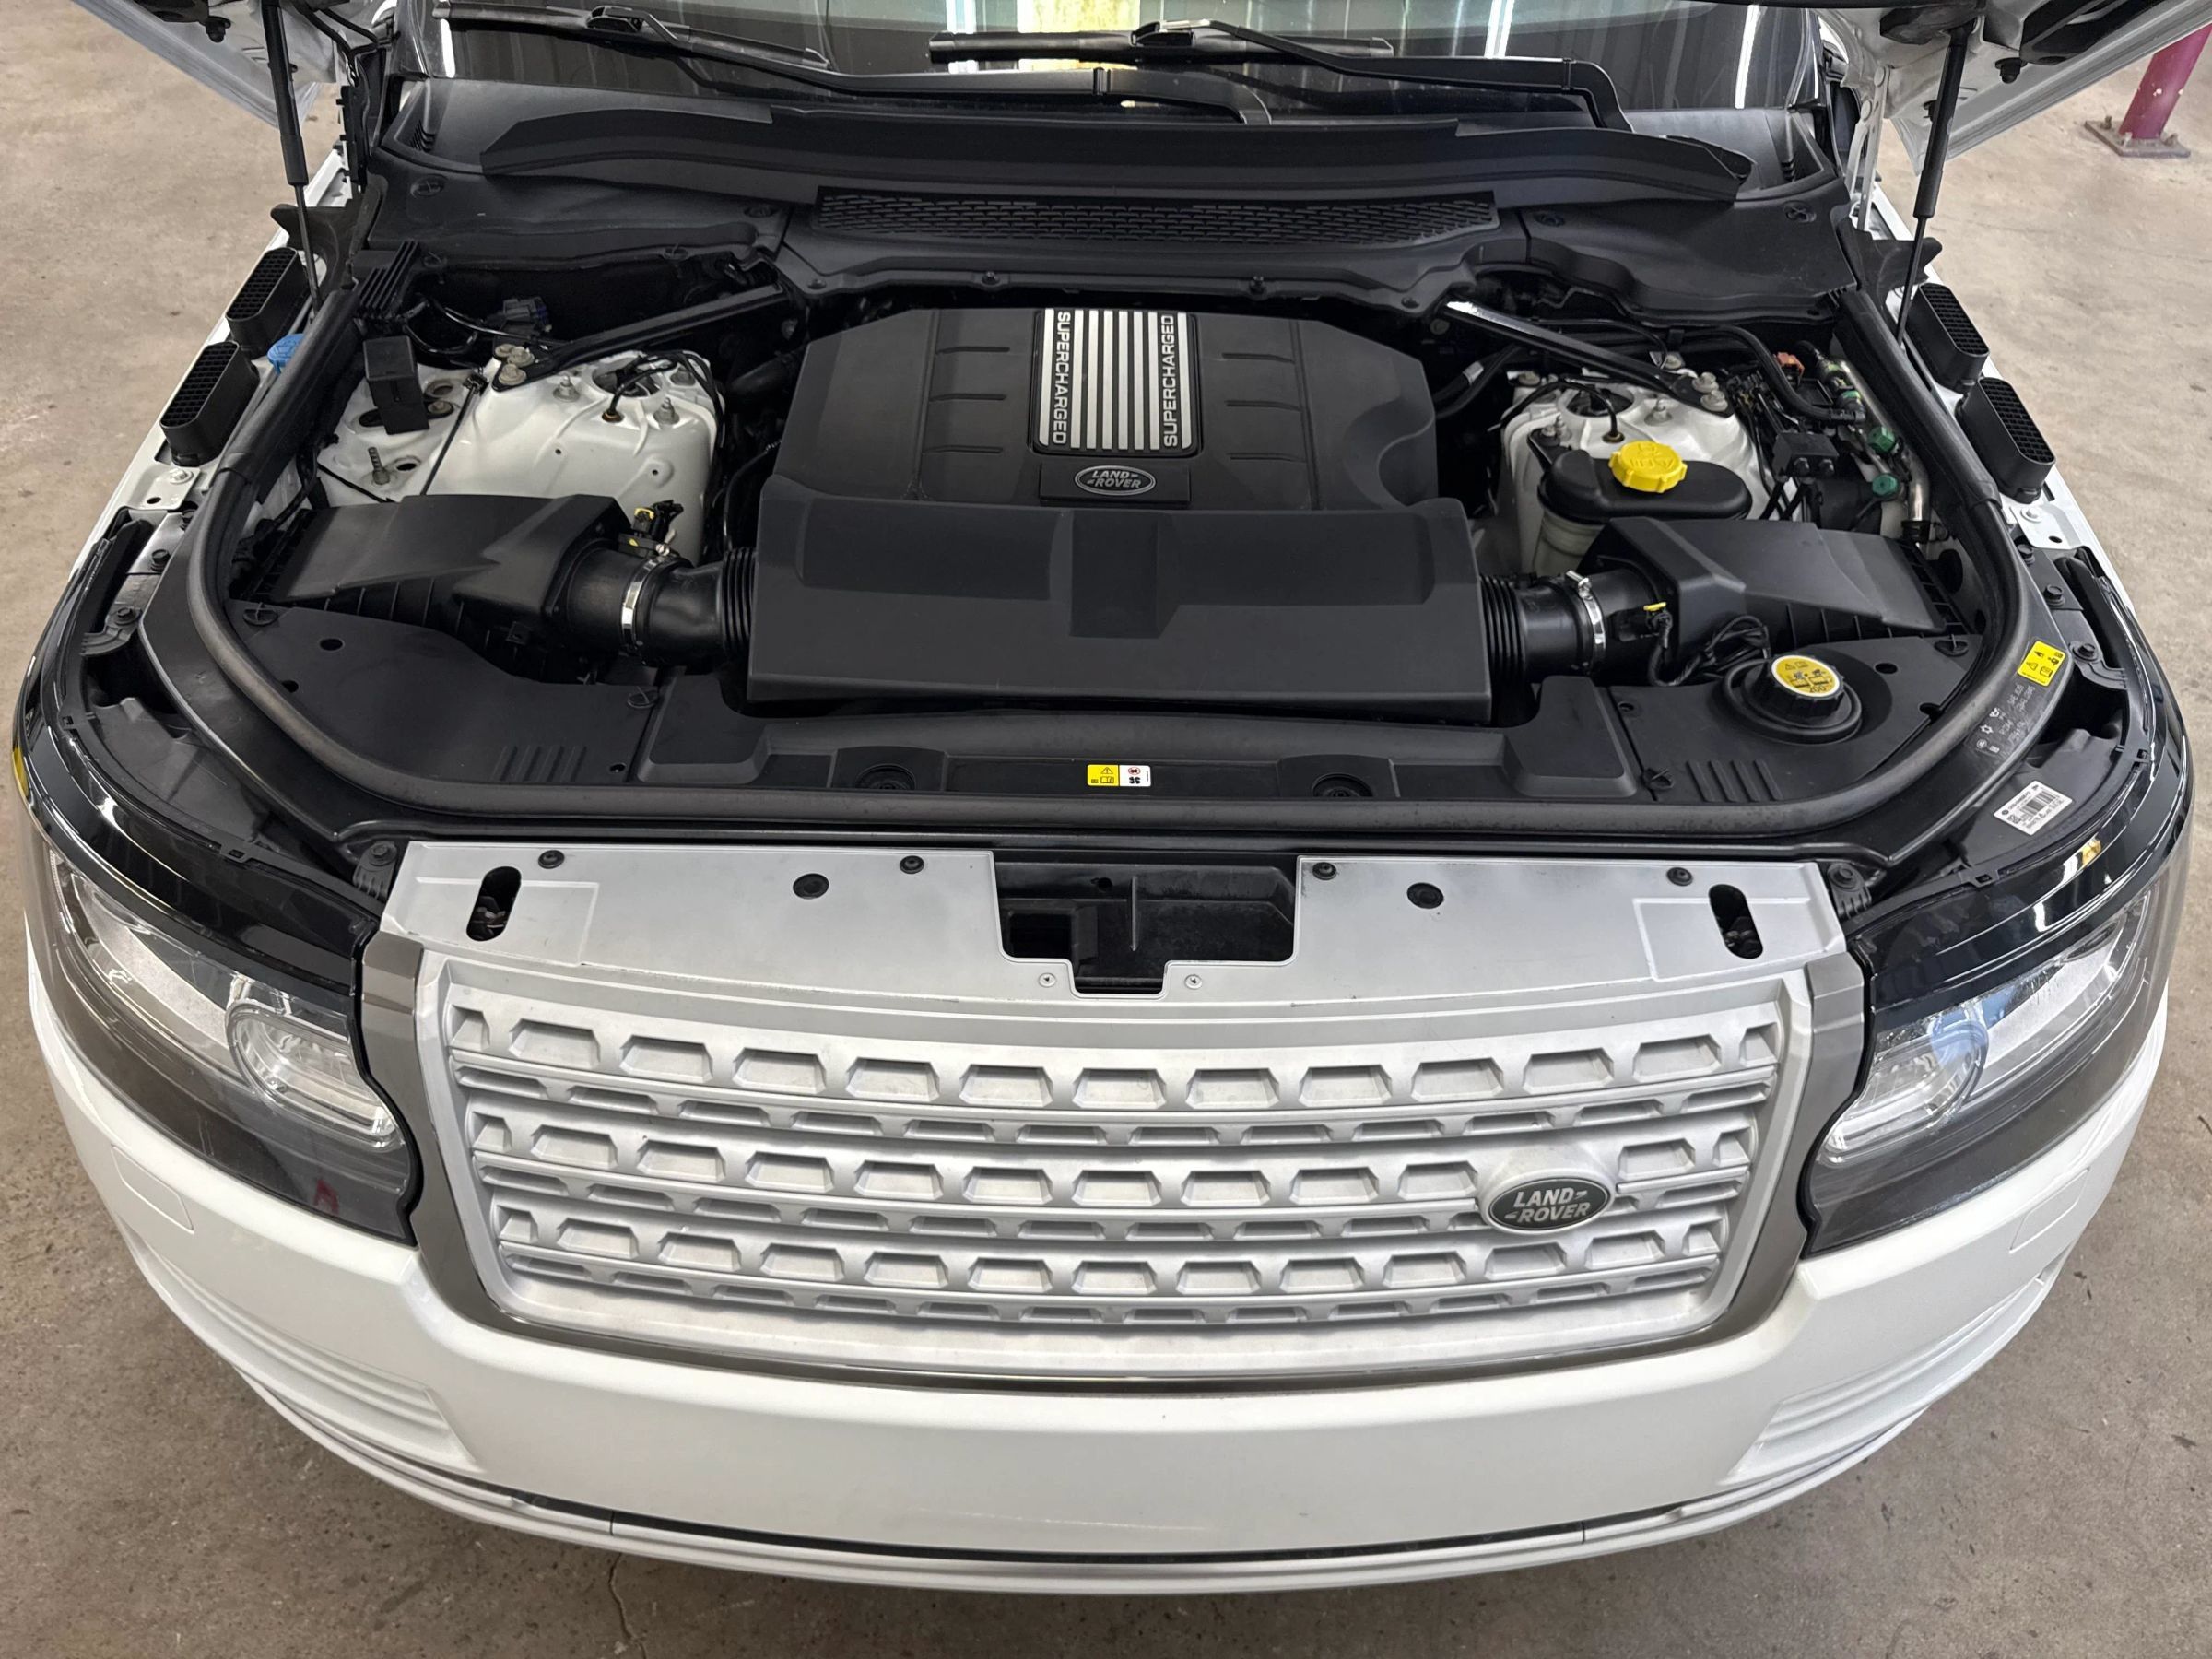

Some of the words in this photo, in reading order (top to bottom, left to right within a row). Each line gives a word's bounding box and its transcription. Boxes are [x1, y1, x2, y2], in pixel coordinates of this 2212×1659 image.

[1053, 311, 1071, 445] SUPERCHARGED
[1160, 314, 1178, 447] SUPERCHARGED
[1091, 470, 1132, 479] LAND
[1096, 477, 1142, 488] ROVER
[1513, 1187, 1574, 1208] LAND
[1517, 1202, 1591, 1223] ROVER
